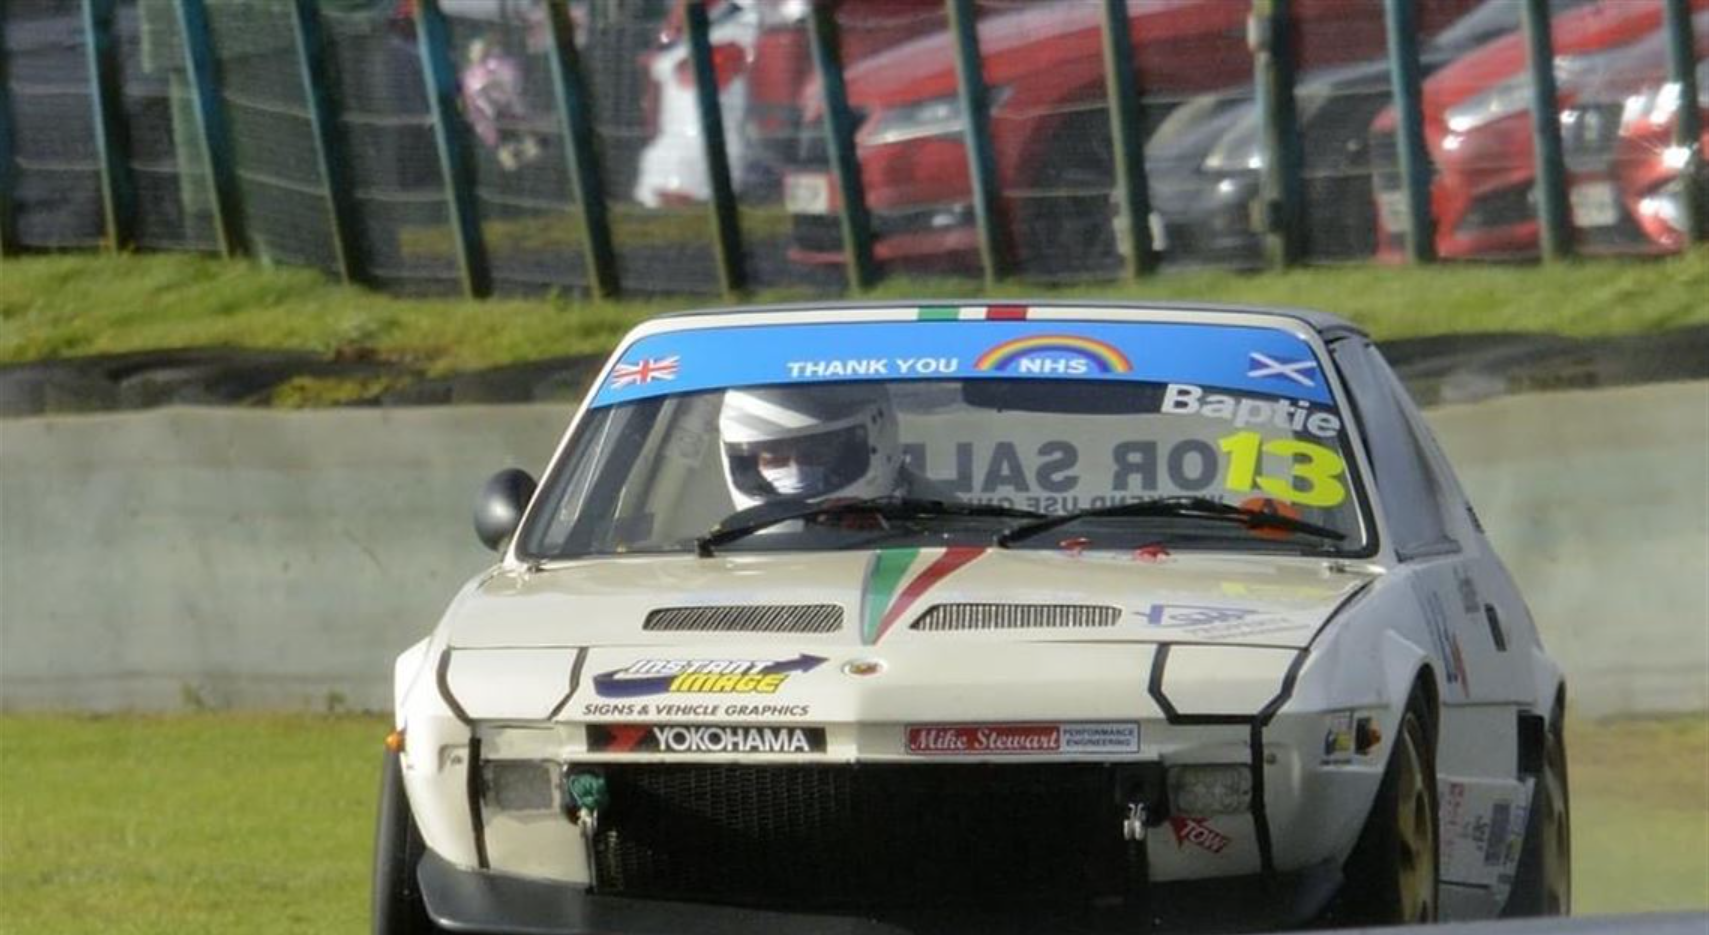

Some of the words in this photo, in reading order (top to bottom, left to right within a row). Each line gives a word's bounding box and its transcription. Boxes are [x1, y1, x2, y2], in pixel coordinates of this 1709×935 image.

[786, 359, 887, 377] THANK
[894, 357, 960, 375] YOU
[1018, 358, 1088, 374] NHS
[1160, 383, 1342, 438] Baptie
[1217, 431, 1346, 509] 13
[666, 673, 791, 694] IMAGE
[583, 703, 634, 717] SIGNS
[637, 704, 650, 716] &
[653, 704, 720, 717] VEHICLE
[724, 704, 811, 717] GRAPHICS
[652, 726, 810, 752] YOKOHAMA
[910, 727, 968, 750] Mike
[974, 726, 1060, 750] Stewart
[1180, 819, 1221, 851] TOW
